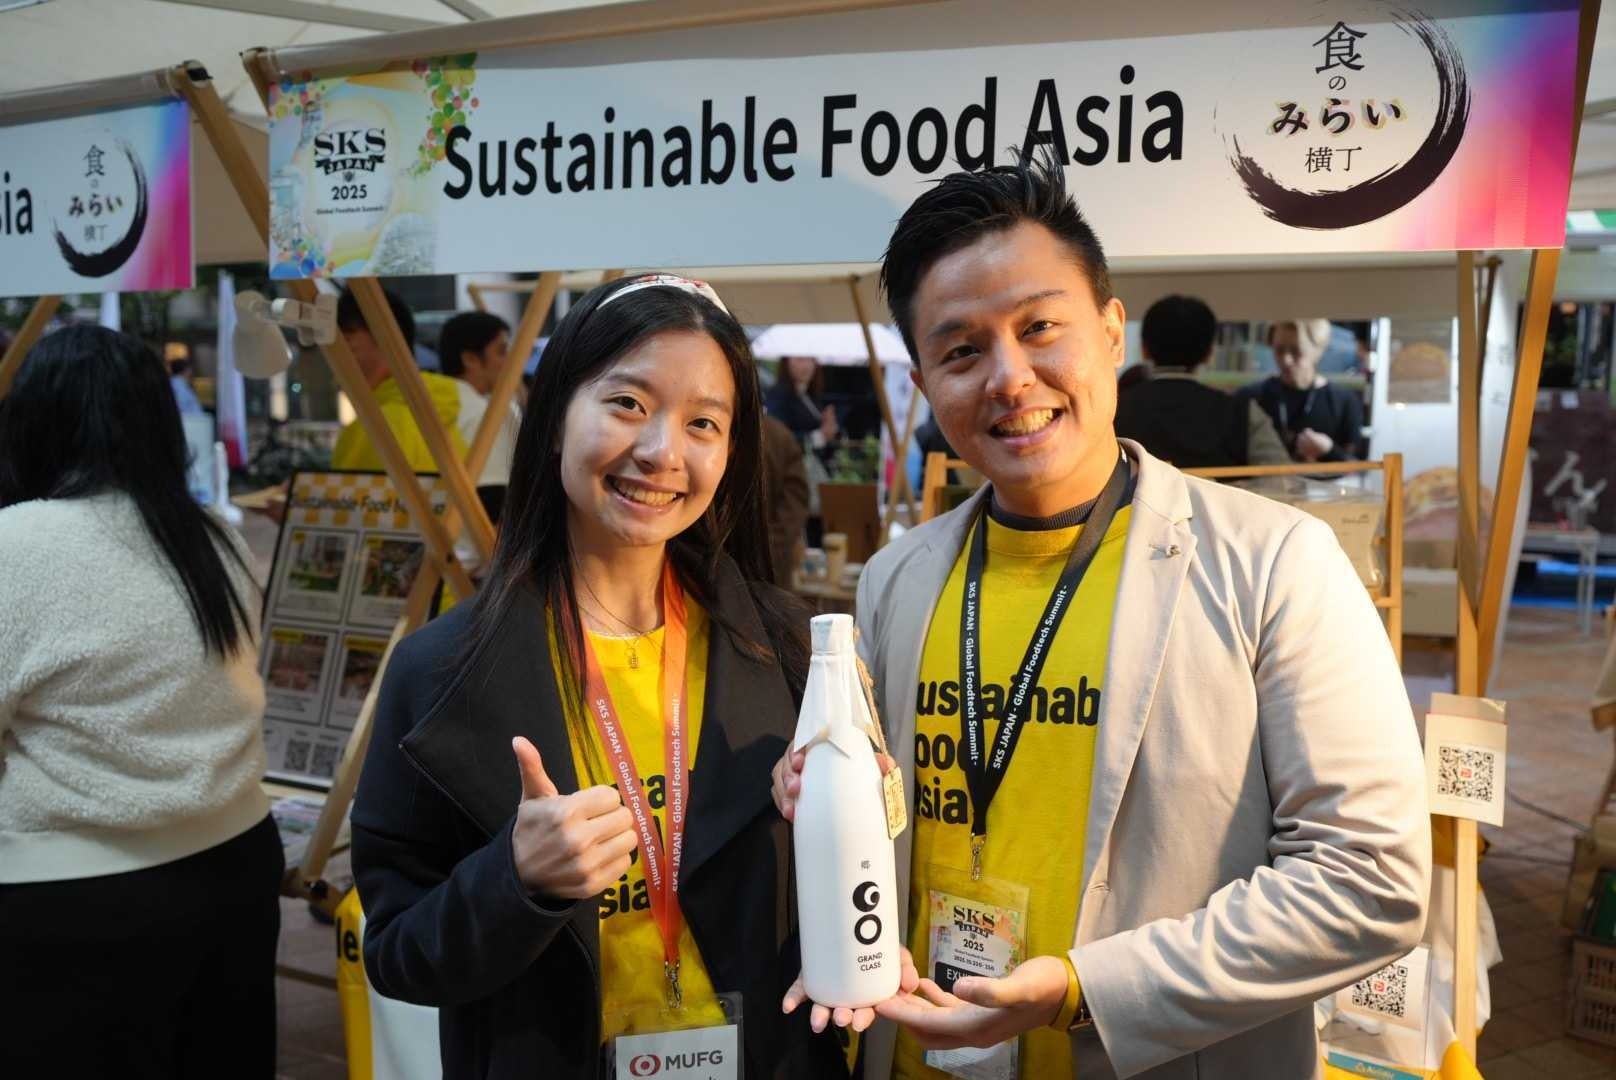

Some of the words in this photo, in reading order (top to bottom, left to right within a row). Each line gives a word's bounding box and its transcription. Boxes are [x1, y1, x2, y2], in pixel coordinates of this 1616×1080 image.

[1312, 21, 1368, 74] 食
[1328, 75, 1347, 91] の
[443, 96, 798, 200] Sustainable
[820, 76, 998, 178] Food
[1020, 64, 1184, 171] Asia
[1271, 98, 1402, 136] みらい
[314, 128, 386, 157] SKS
[83, 145, 105, 177] 食
[325, 158, 376, 174] JAPAN
[1304, 146, 1362, 173] 横丁
[0, 171, 33, 235] ia
[68, 193, 123, 218] みらい
[331, 184, 368, 200] 2025
[968, 581, 976, 599] SKS
[966, 600, 976, 630] JAPAN
[965, 638, 974, 670] Global
[966, 670, 976, 719] Foodtech
[993, 749, 1006, 769] SKS
[1000, 713, 1018, 750] JAPAN
[1013, 671, 1032, 706] Global
[1026, 626, 1050, 672] Foodtech
[1045, 590, 1066, 627] Summit
[671, 702, 681, 738] Summit
[968, 720, 979, 760] Summit
[672, 739, 682, 787] Foodtech
[596, 699, 609, 720] SKS
[603, 720, 623, 756] JAPAN
[618, 761, 638, 796] Global
[630, 795, 652, 847] Foodtech
[645, 846, 661, 887] Summit
[672, 787, 682, 824] Global
[915, 776, 969, 825] sia
[672, 832, 684, 867] JAPAN
[597, 874, 651, 919] sia
[953, 904, 995, 929] SKS
[857, 951, 883, 964] GRAND
[963, 938, 985, 952] 2025
[860, 960, 882, 972] CLASS
[665, 1050, 723, 1071] MUFG
